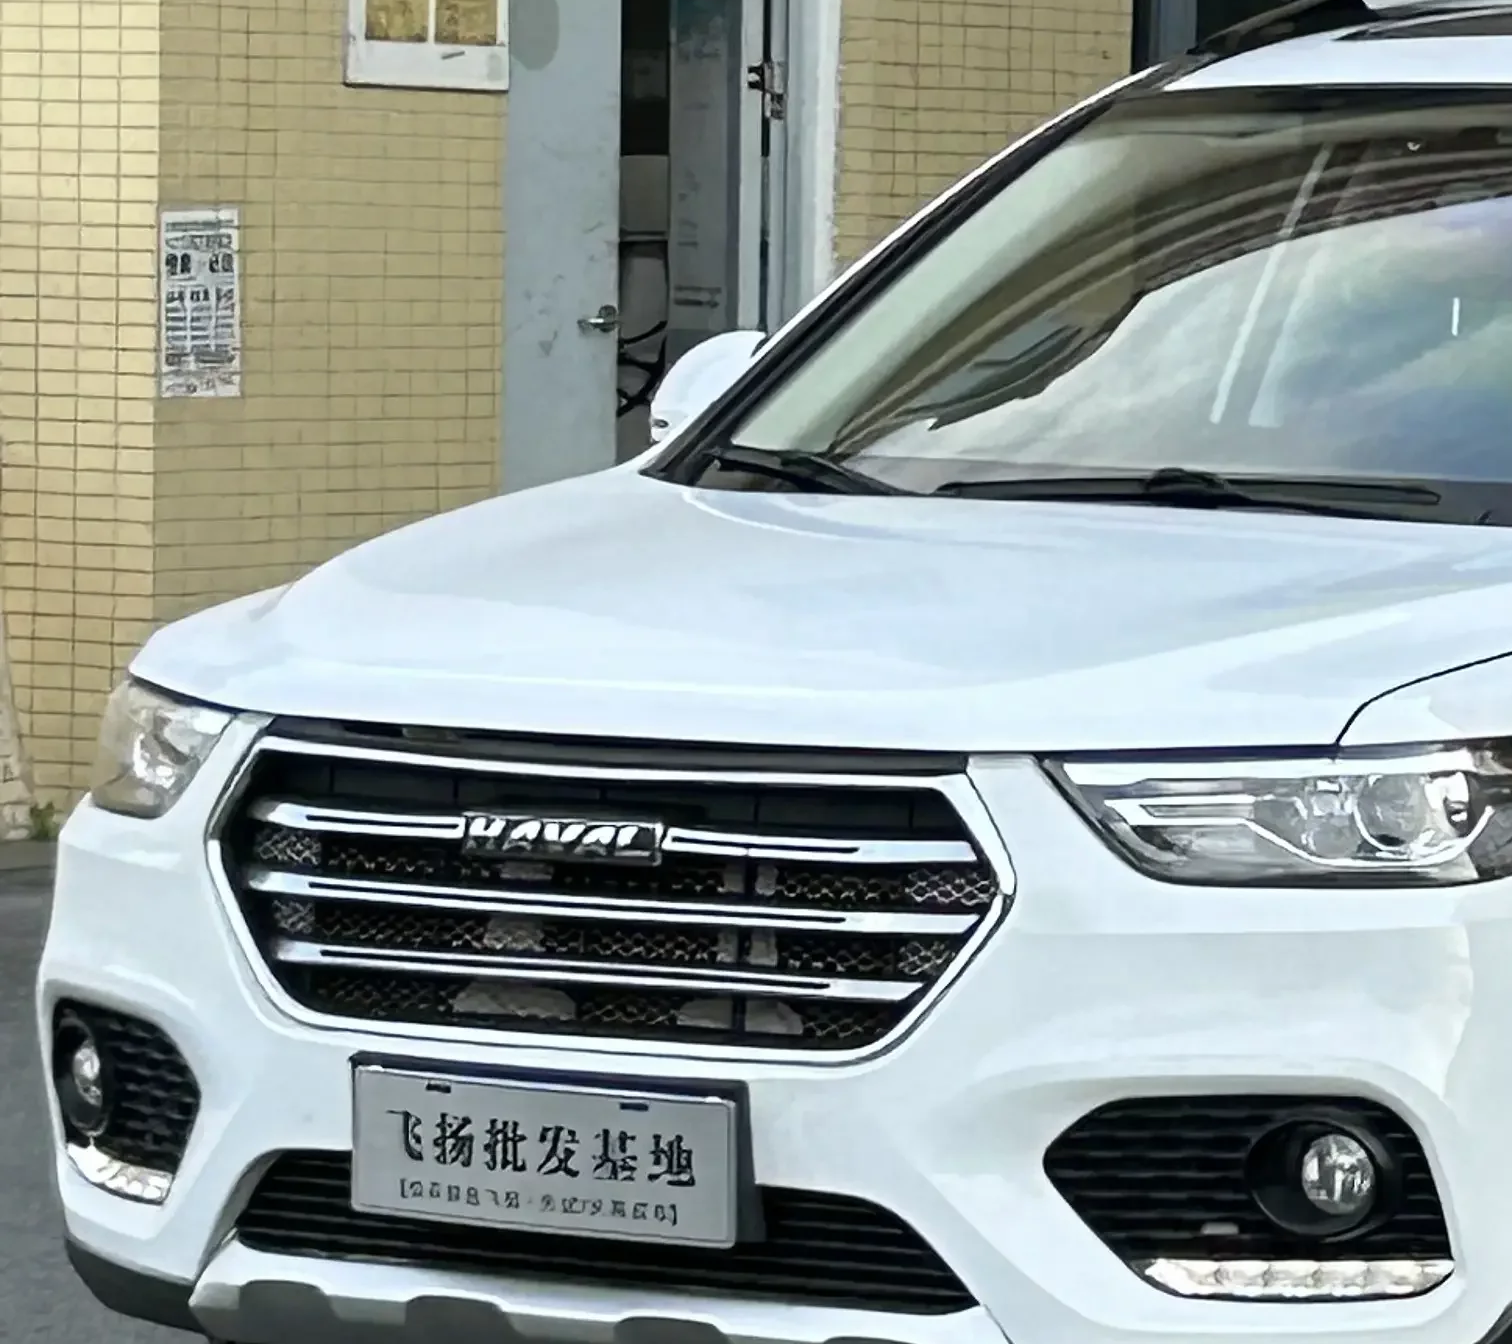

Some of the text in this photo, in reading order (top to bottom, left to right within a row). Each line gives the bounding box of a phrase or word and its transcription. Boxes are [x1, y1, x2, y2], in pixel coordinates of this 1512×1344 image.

[463, 812, 659, 860] HAVAL
[387, 1109, 696, 1187] 飞扬批发基地
